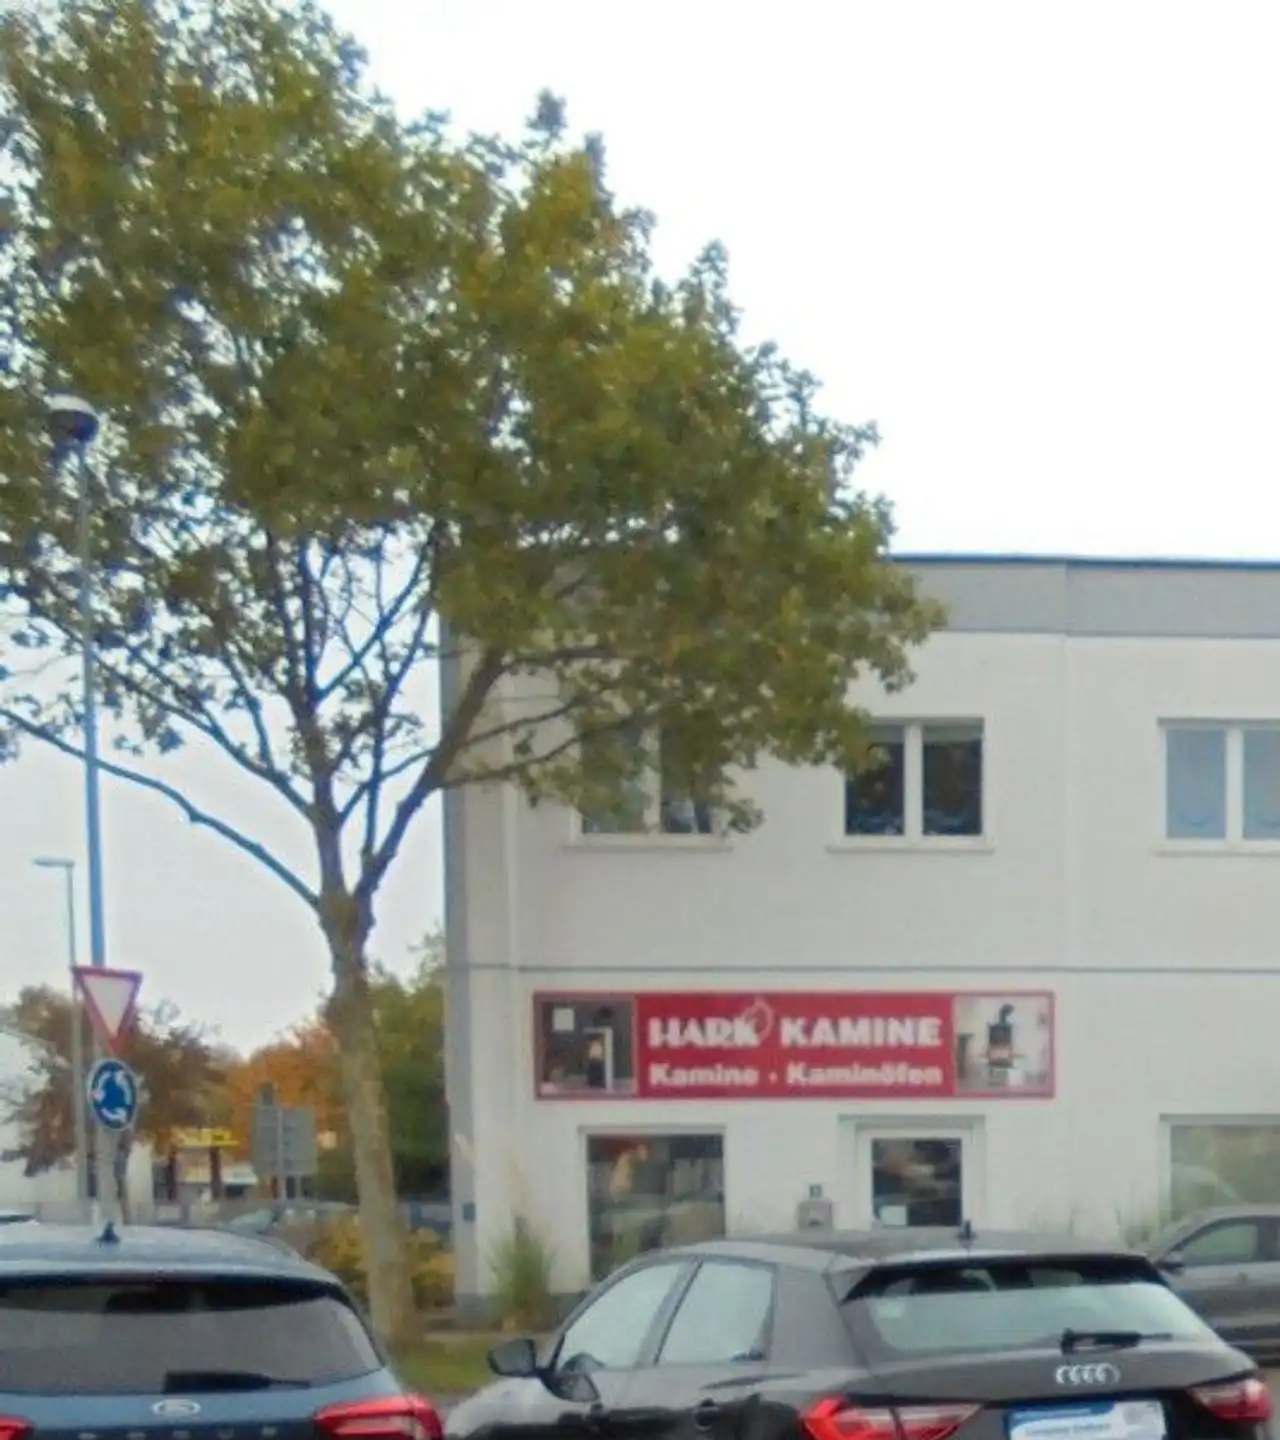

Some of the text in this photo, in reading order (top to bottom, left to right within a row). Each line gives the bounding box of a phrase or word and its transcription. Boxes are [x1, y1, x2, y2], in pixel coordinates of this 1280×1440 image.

[648, 1016, 942, 1047] HARK KAMINE
[649, 1060, 943, 1087] Kamine Kaminöfen
